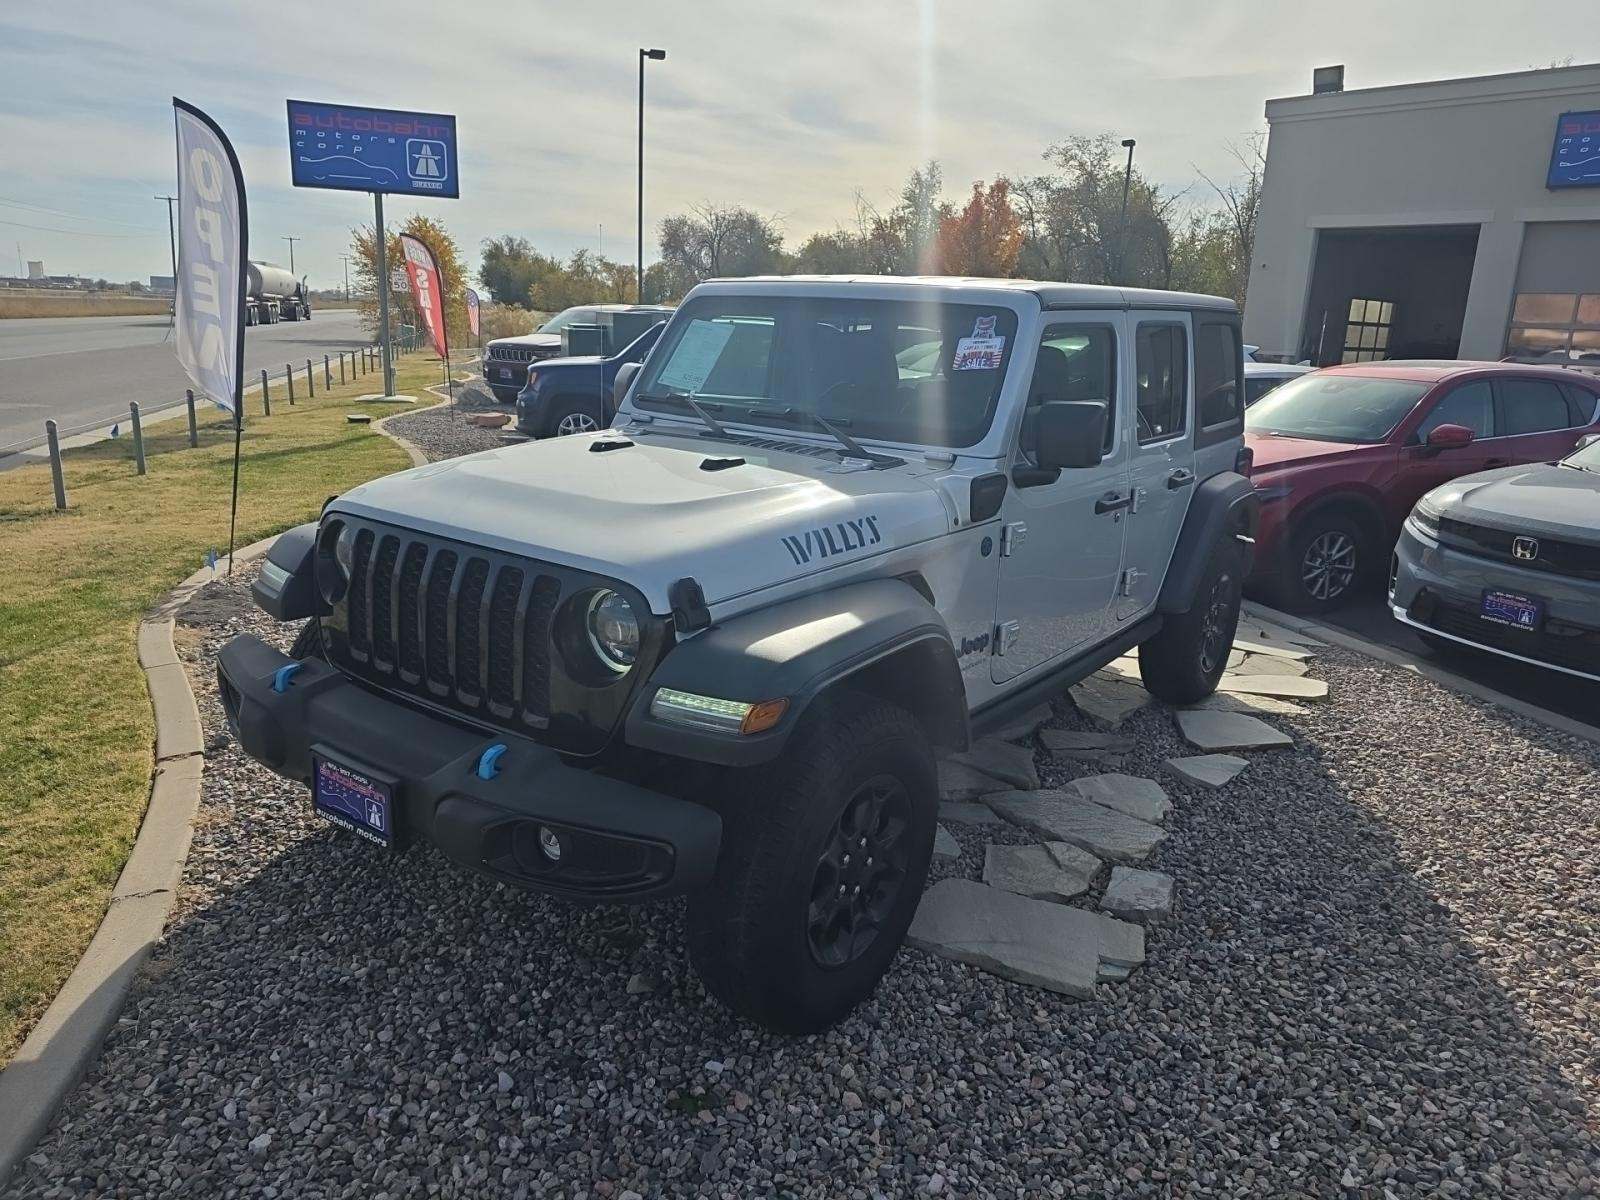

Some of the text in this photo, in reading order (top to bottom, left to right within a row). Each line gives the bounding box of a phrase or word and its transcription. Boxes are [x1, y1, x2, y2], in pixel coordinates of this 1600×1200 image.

[293, 112, 450, 138] autobahn
[296, 129, 396, 144] motors
[296, 141, 363, 153] corp
[393, 281, 407, 289] 50
[966, 358, 987, 368] SALE
[781, 515, 881, 565] WILLYS
[955, 632, 990, 658] Jeep
[316, 807, 387, 847] autobahn motors
